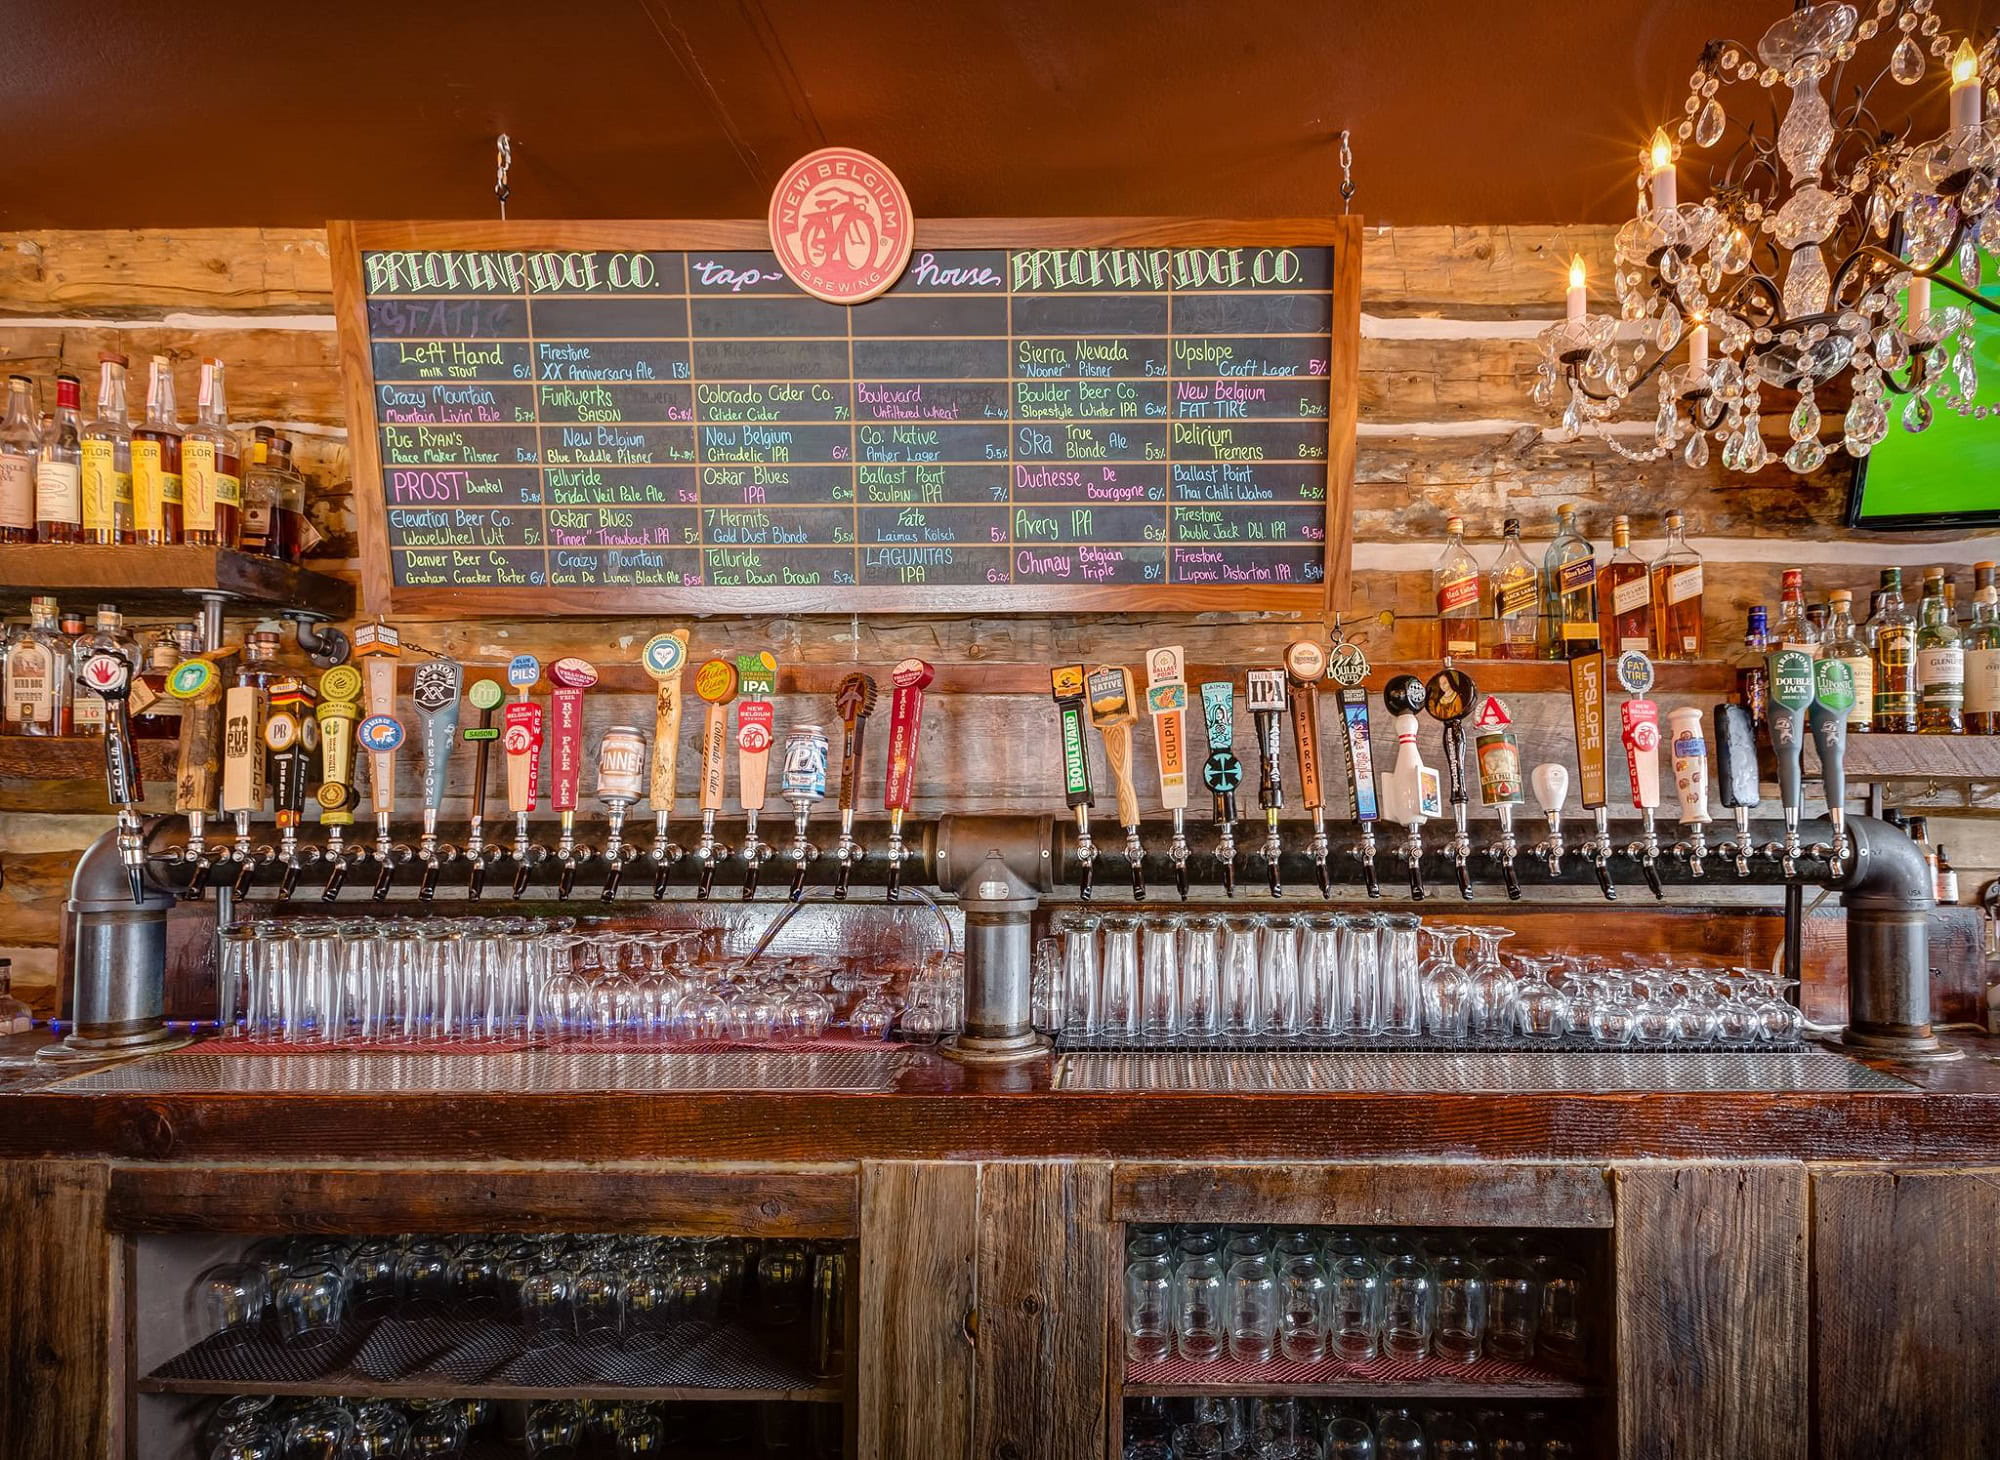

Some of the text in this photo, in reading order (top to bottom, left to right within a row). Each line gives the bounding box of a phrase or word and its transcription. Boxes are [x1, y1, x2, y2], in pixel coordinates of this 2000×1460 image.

[782, 162, 898, 229] NEW BELGIUM
[801, 270, 881, 293] BREWING
[400, 343, 503, 365] Left Hand
[1019, 341, 1128, 364] Sierra Nevada
[1175, 340, 1233, 370] Upslope
[542, 365, 655, 379] XX Ale
[1079, 361, 1112, 377] Pilsner
[1219, 359, 1258, 376] Craft
[382, 385, 495, 408] Crazy Mountain
[542, 385, 612, 407] Funkwerks
[698, 384, 805, 404] Colorado Cider
[858, 383, 922, 403] Boulevard
[1017, 382, 1111, 403] Boulder Beer
[1177, 380, 1266, 404] New Belgium
[710, 407, 780, 421] Glider Cider
[1120, 402, 1137, 417] IPA
[1179, 402, 1210, 418] FAT
[563, 427, 645, 450] New Belgium
[705, 425, 792, 449] New Belgium
[893, 427, 940, 445] Native
[1019, 428, 1053, 455] Ska
[1065, 424, 1093, 440] True
[1175, 423, 1232, 446] Delirium
[392, 446, 499, 463] Peace Maker Pilsner
[772, 447, 788, 462] IPA
[866, 447, 900, 461] Amber
[1066, 432, 1128, 458] Blonde Ale
[1212, 444, 1263, 460] Tremens
[548, 449, 653, 464] Blue Paddle Pilsner
[544, 468, 602, 487] Telluride
[704, 466, 789, 485] Oskar Blues
[860, 465, 946, 484] Ballast Point
[1016, 464, 1117, 488] Duchesse De
[1174, 464, 1252, 482] Ballast Point
[620, 485, 665, 502] Pale Ale
[744, 487, 766, 503] IPA
[922, 484, 943, 502] IPA
[1088, 482, 1144, 501] Bourgogne
[1176, 485, 1201, 499] Thai
[391, 509, 484, 528] Elevation Beer
[551, 509, 633, 528] Oskar Blues
[704, 509, 769, 528] 7 Hermits
[897, 507, 926, 527] Fate
[1175, 507, 1223, 522] Firestone
[1016, 509, 1093, 540] Avery IPA
[1179, 521, 1287, 540] Double Jack IPA
[481, 532, 505, 545] Wit
[655, 528, 669, 543] IPA
[714, 526, 808, 544] Gold Dust Blonde
[406, 551, 481, 568] Denver Beer
[558, 551, 663, 570] Crazy Mountain
[705, 548, 762, 567] Telluride
[867, 547, 953, 566] LAGUNITAS
[1017, 546, 1123, 577] Chimay Belgian
[1175, 548, 1223, 563] Firestone
[714, 567, 819, 585] Face Down Brown
[901, 566, 925, 583] IPA
[1153, 665, 1177, 674] BALLAST
[1327, 665, 1371, 679] BOULDER
[1627, 662, 1644, 670] FAT
[1777, 652, 1809, 673] FIRESTONE
[1820, 662, 1850, 681] FIRESTONE
[417, 663, 455, 686] FIRESTONE
[511, 668, 536, 680] PILS
[1626, 670, 1648, 681] TIRE
[1775, 678, 1812, 686] DOUBLE
[1817, 677, 1853, 690] LUPONIC
[743, 681, 769, 692] IPA
[1091, 680, 1122, 693] NATIVE
[1251, 680, 1284, 703] IPA
[1783, 685, 1807, 694] JACK
[1475, 695, 1512, 728] A
[1583, 662, 1600, 750] UPSLOPE
[227, 734, 248, 744] PUG
[273, 724, 287, 739] PB
[469, 730, 493, 738] SAISON
[107, 702, 124, 797] MILK STOUT
[252, 696, 264, 801] PILSNER
[1064, 715, 1083, 788] BOULEVARD
[1165, 717, 1178, 767] SCULPIN
[1269, 714, 1280, 782] LAGUNITAS
[1300, 712, 1313, 784] SIERRA
[425, 719, 435, 806] FIRESTONE
[528, 709, 541, 805] NEW BELGIUM
[560, 702, 572, 804] RYE PALE ALE
[709, 721, 724, 797] Colorado Cider
[1622, 707, 1640, 802] NEW BELGIUM
